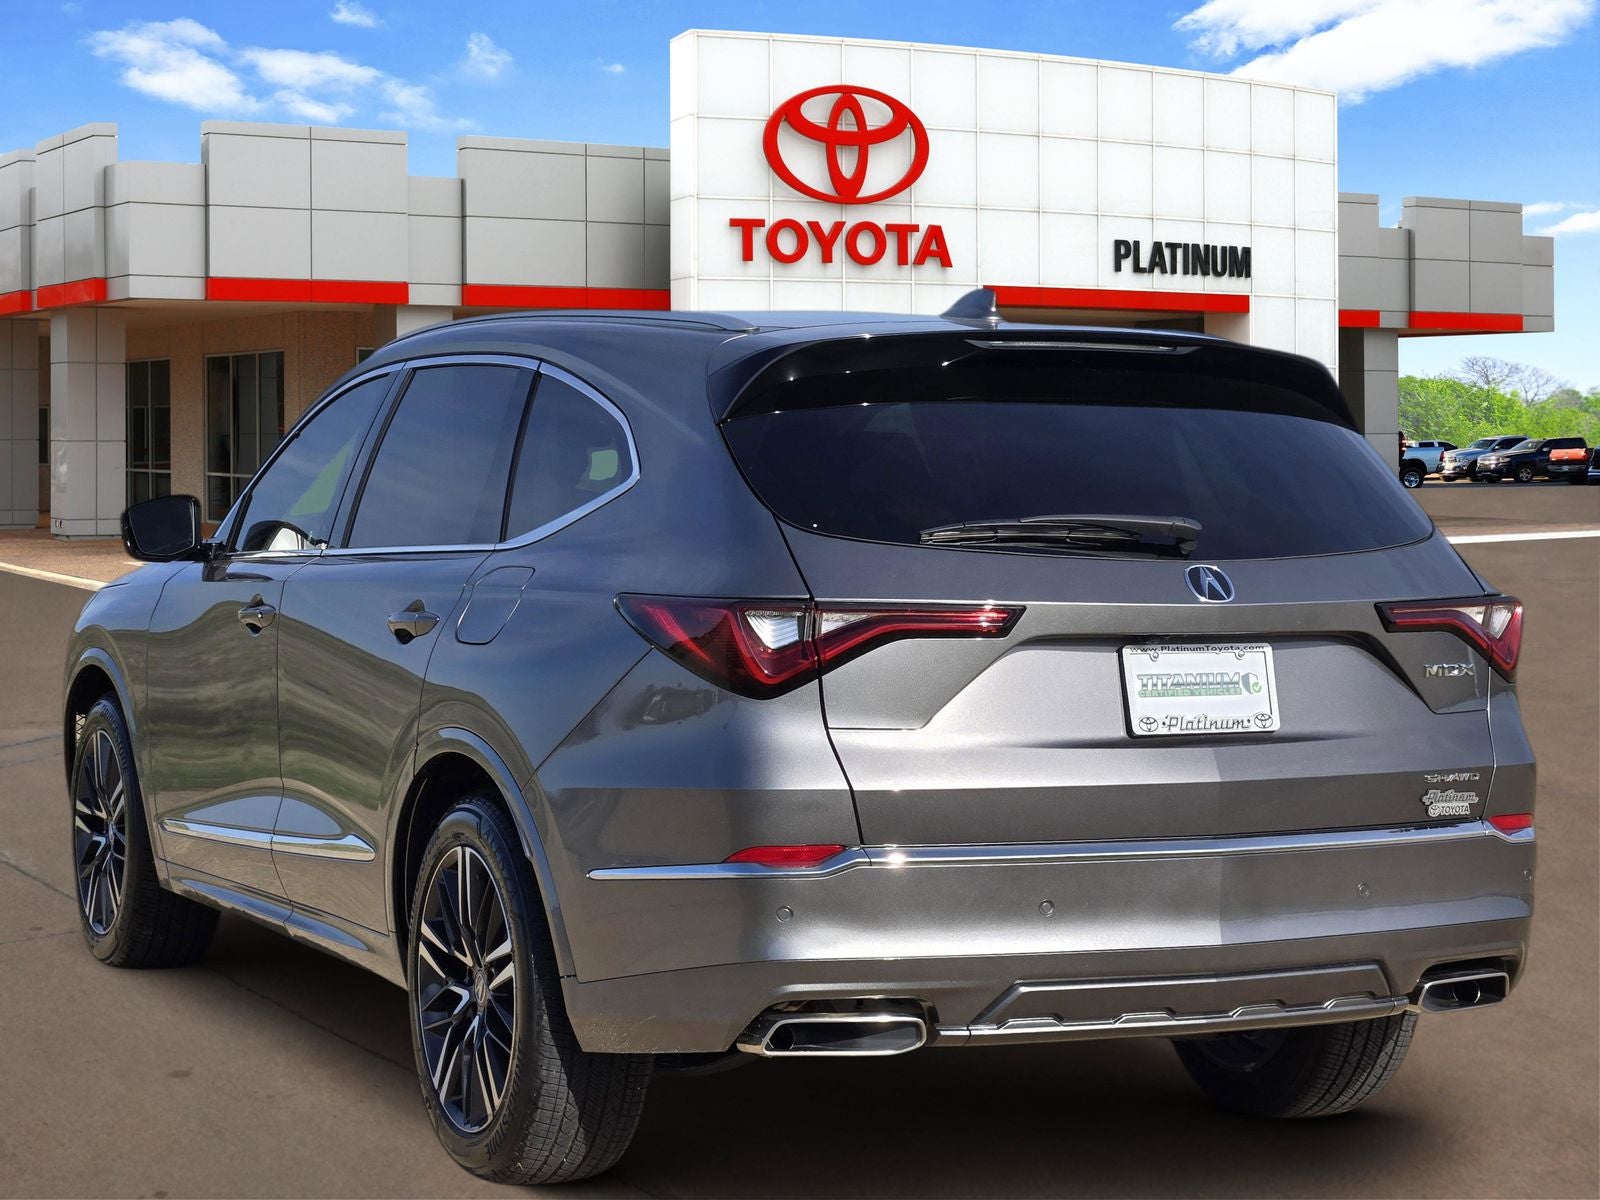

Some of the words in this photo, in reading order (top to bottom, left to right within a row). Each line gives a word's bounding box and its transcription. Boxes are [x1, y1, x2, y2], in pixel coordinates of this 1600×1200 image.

[730, 218, 953, 268] TOYOTA
[1114, 239, 1252, 279] PLATINUM
[1424, 663, 1475, 678] MDX
[1137, 672, 1241, 690] TITANIUM
[1139, 688, 1191, 697] CERTIFIED
[1194, 687, 1242, 696] VEHICLES
[1165, 714, 1250, 732] Platinum
[1423, 789, 1479, 805] Platinum
[1441, 805, 1470, 815] TOYOTA
